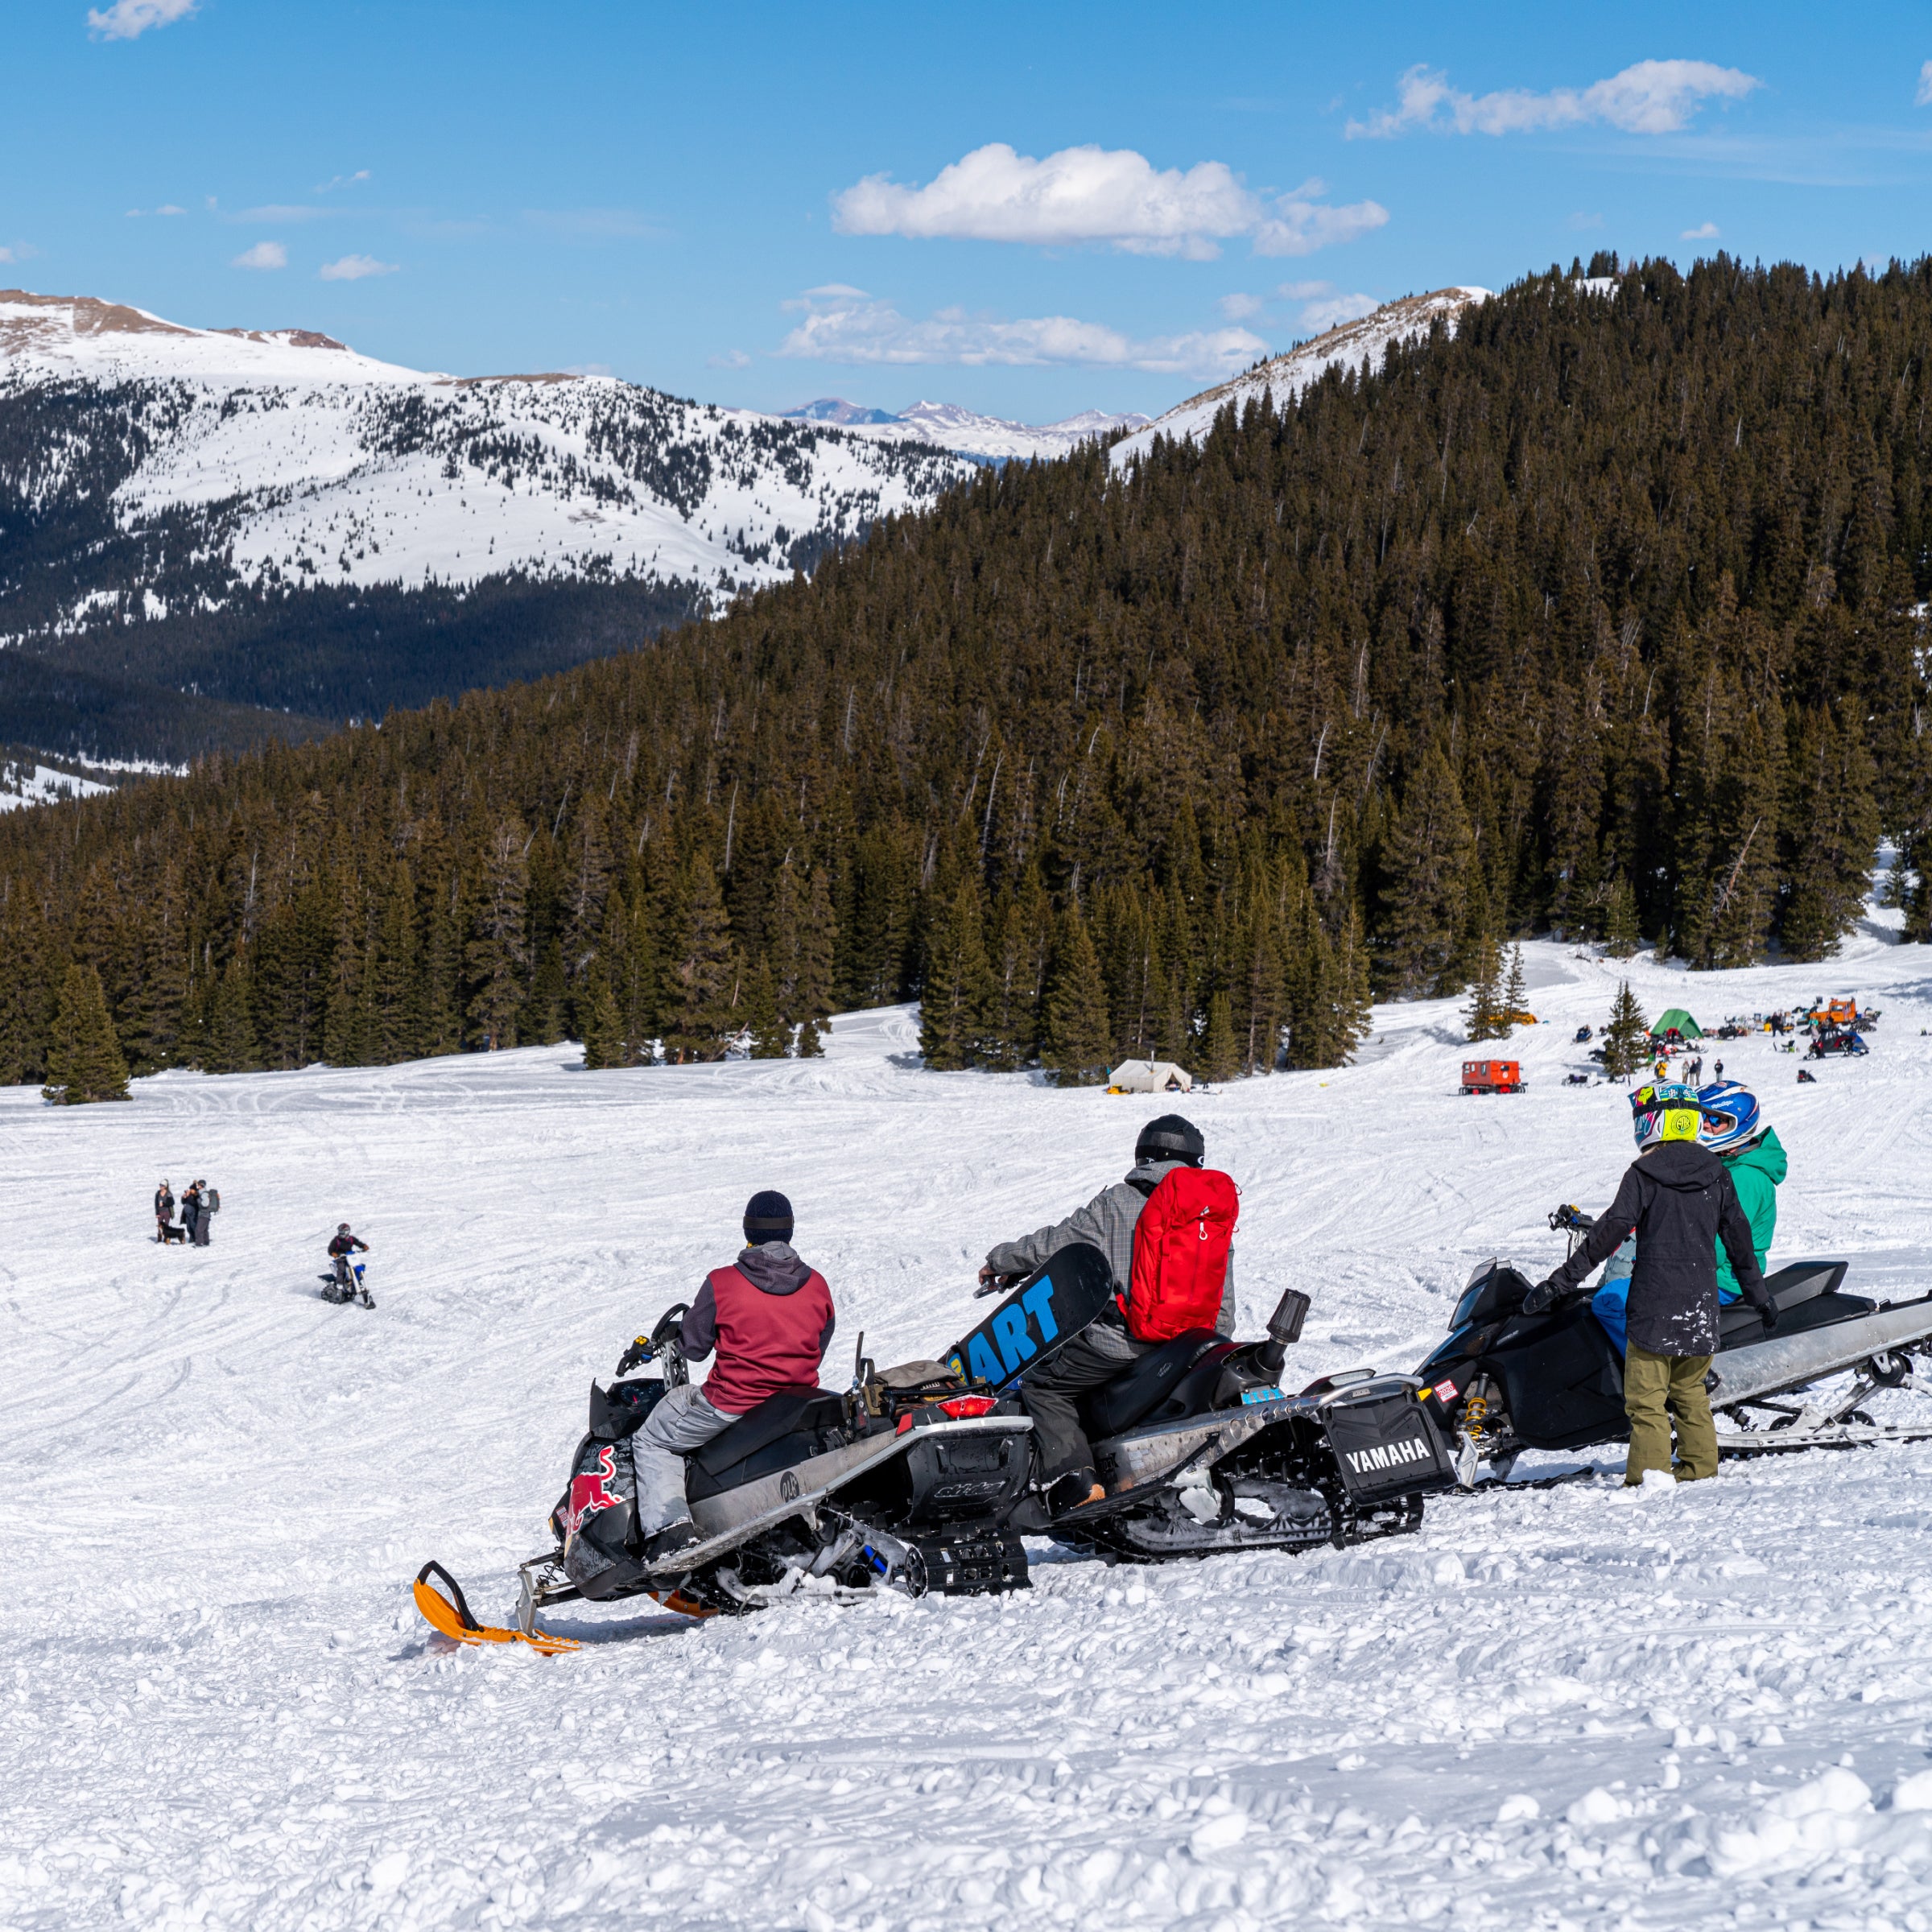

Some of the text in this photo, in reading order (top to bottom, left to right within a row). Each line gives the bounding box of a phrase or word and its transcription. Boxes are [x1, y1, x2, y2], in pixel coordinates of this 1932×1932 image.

[968, 1274, 1059, 1386] ART
[1438, 1385, 1454, 1397] 2020
[1346, 1438, 1430, 1473] YAMAHA
